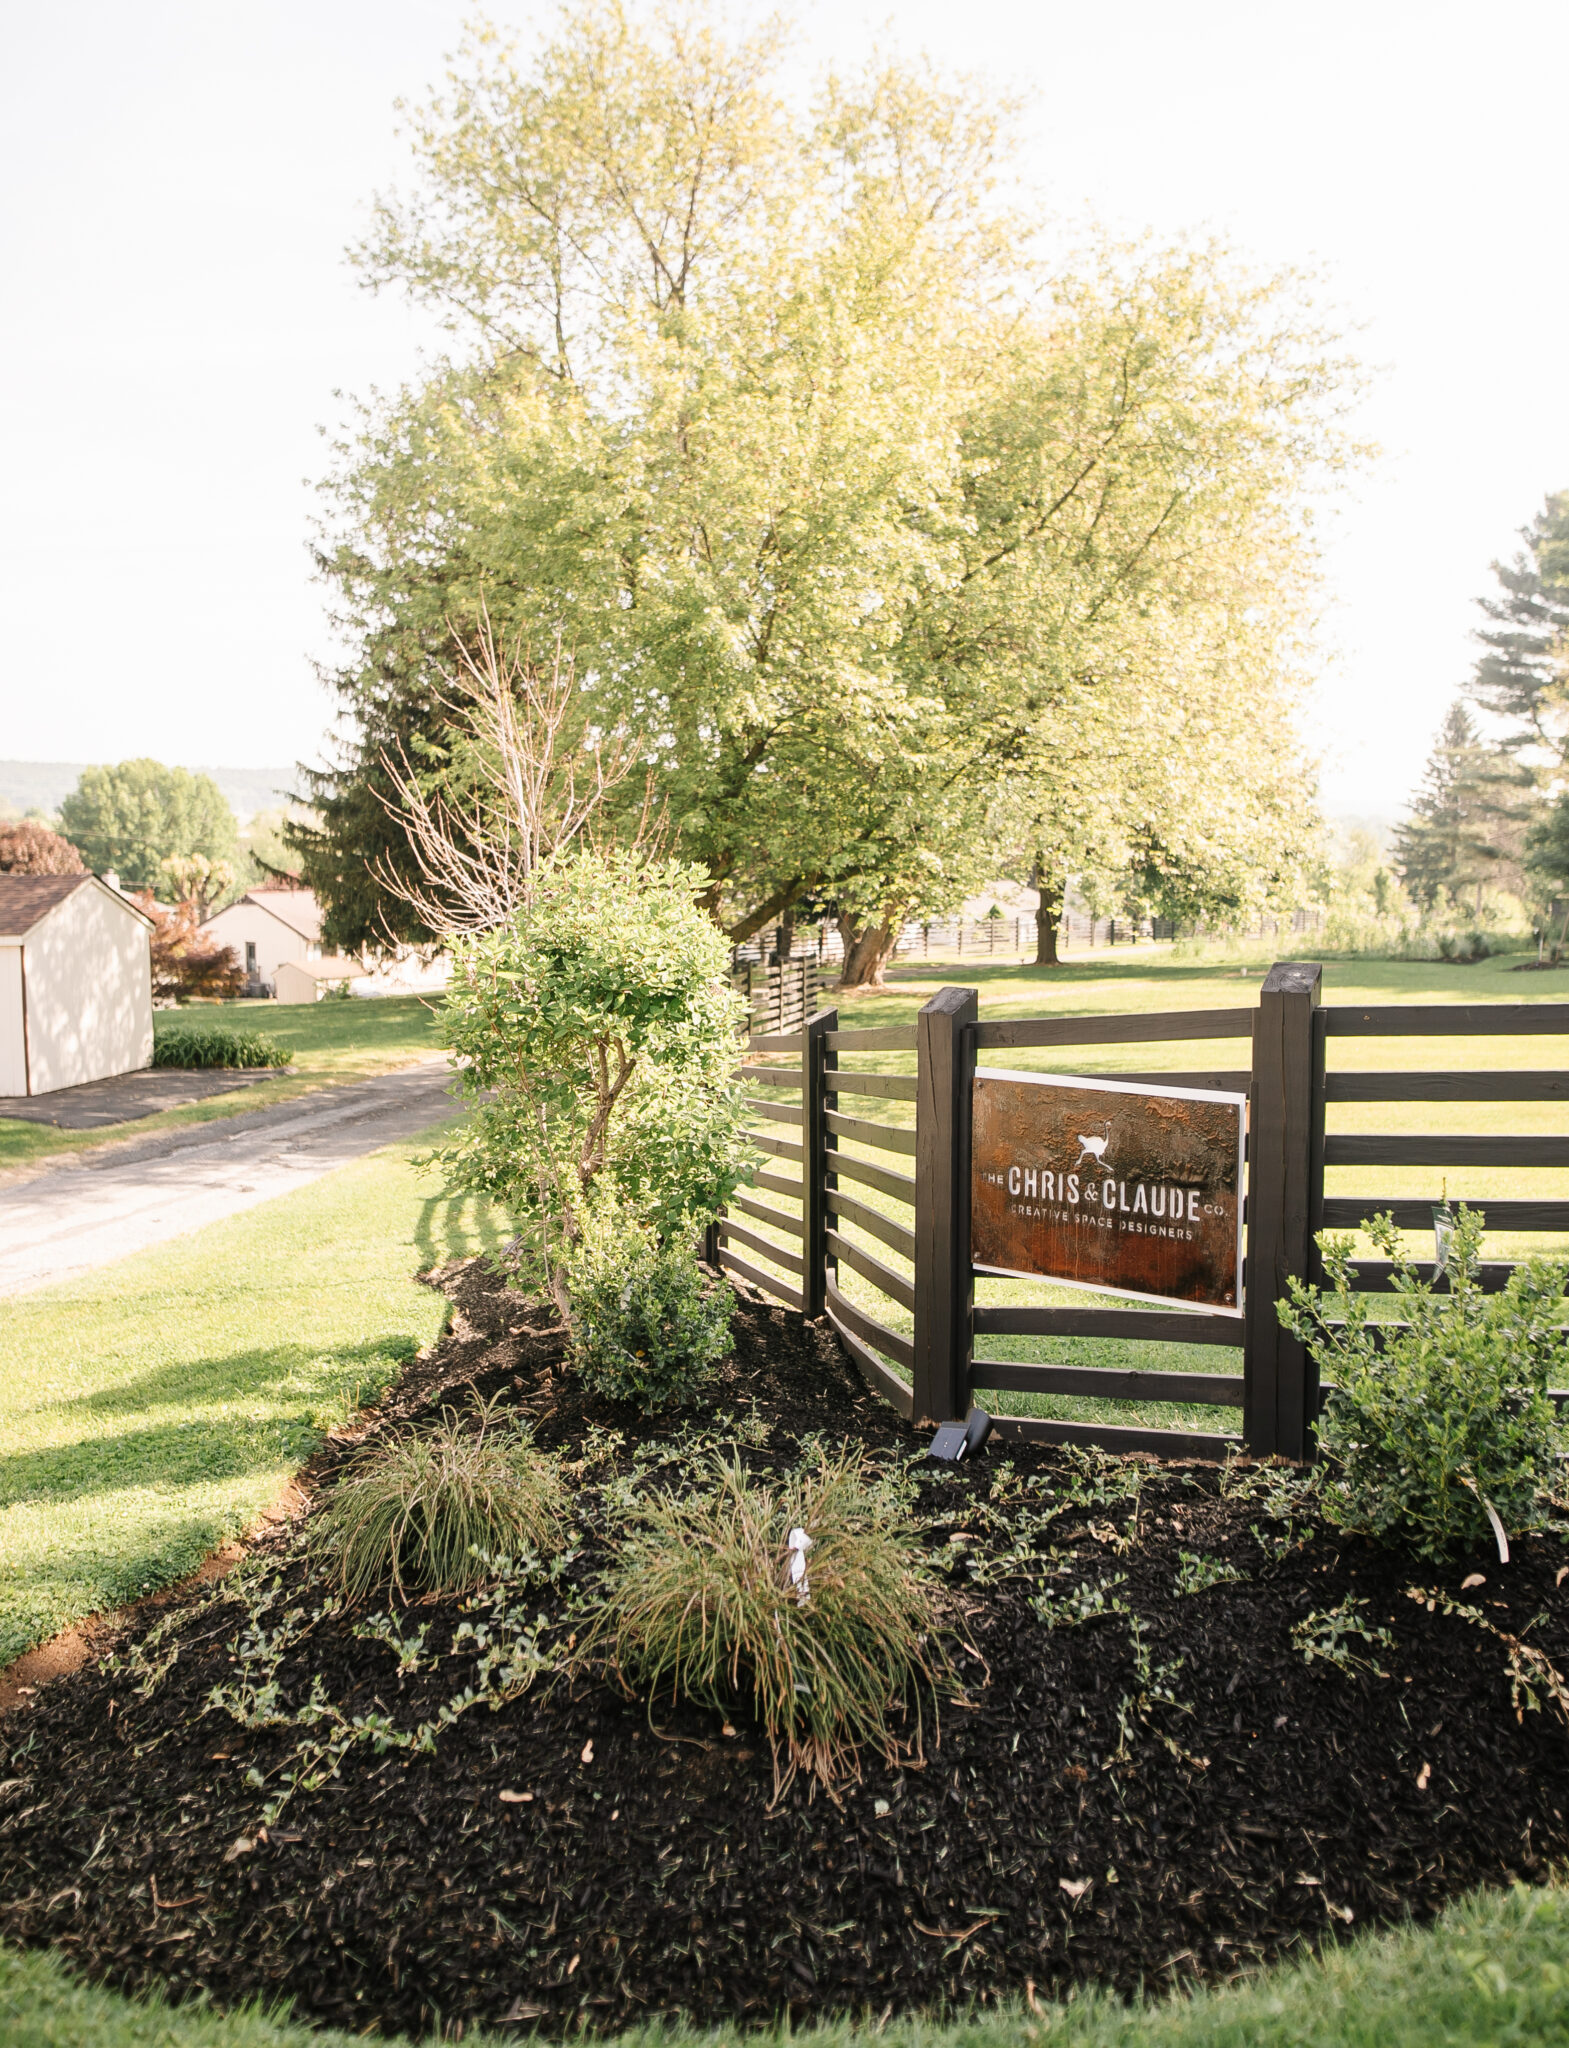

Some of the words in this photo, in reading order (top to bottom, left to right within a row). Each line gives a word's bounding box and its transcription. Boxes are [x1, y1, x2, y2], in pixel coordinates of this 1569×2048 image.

[981, 1172, 1004, 1185] THE
[1008, 1166, 1080, 1204] CHRIS
[1084, 1182, 1098, 1201] &
[1102, 1179, 1200, 1222] CLAUDE
[1010, 1204, 1068, 1221] CREATIVE
[1074, 1213, 1113, 1229] SPACE
[1119, 1220, 1193, 1241] DESIGNERS
